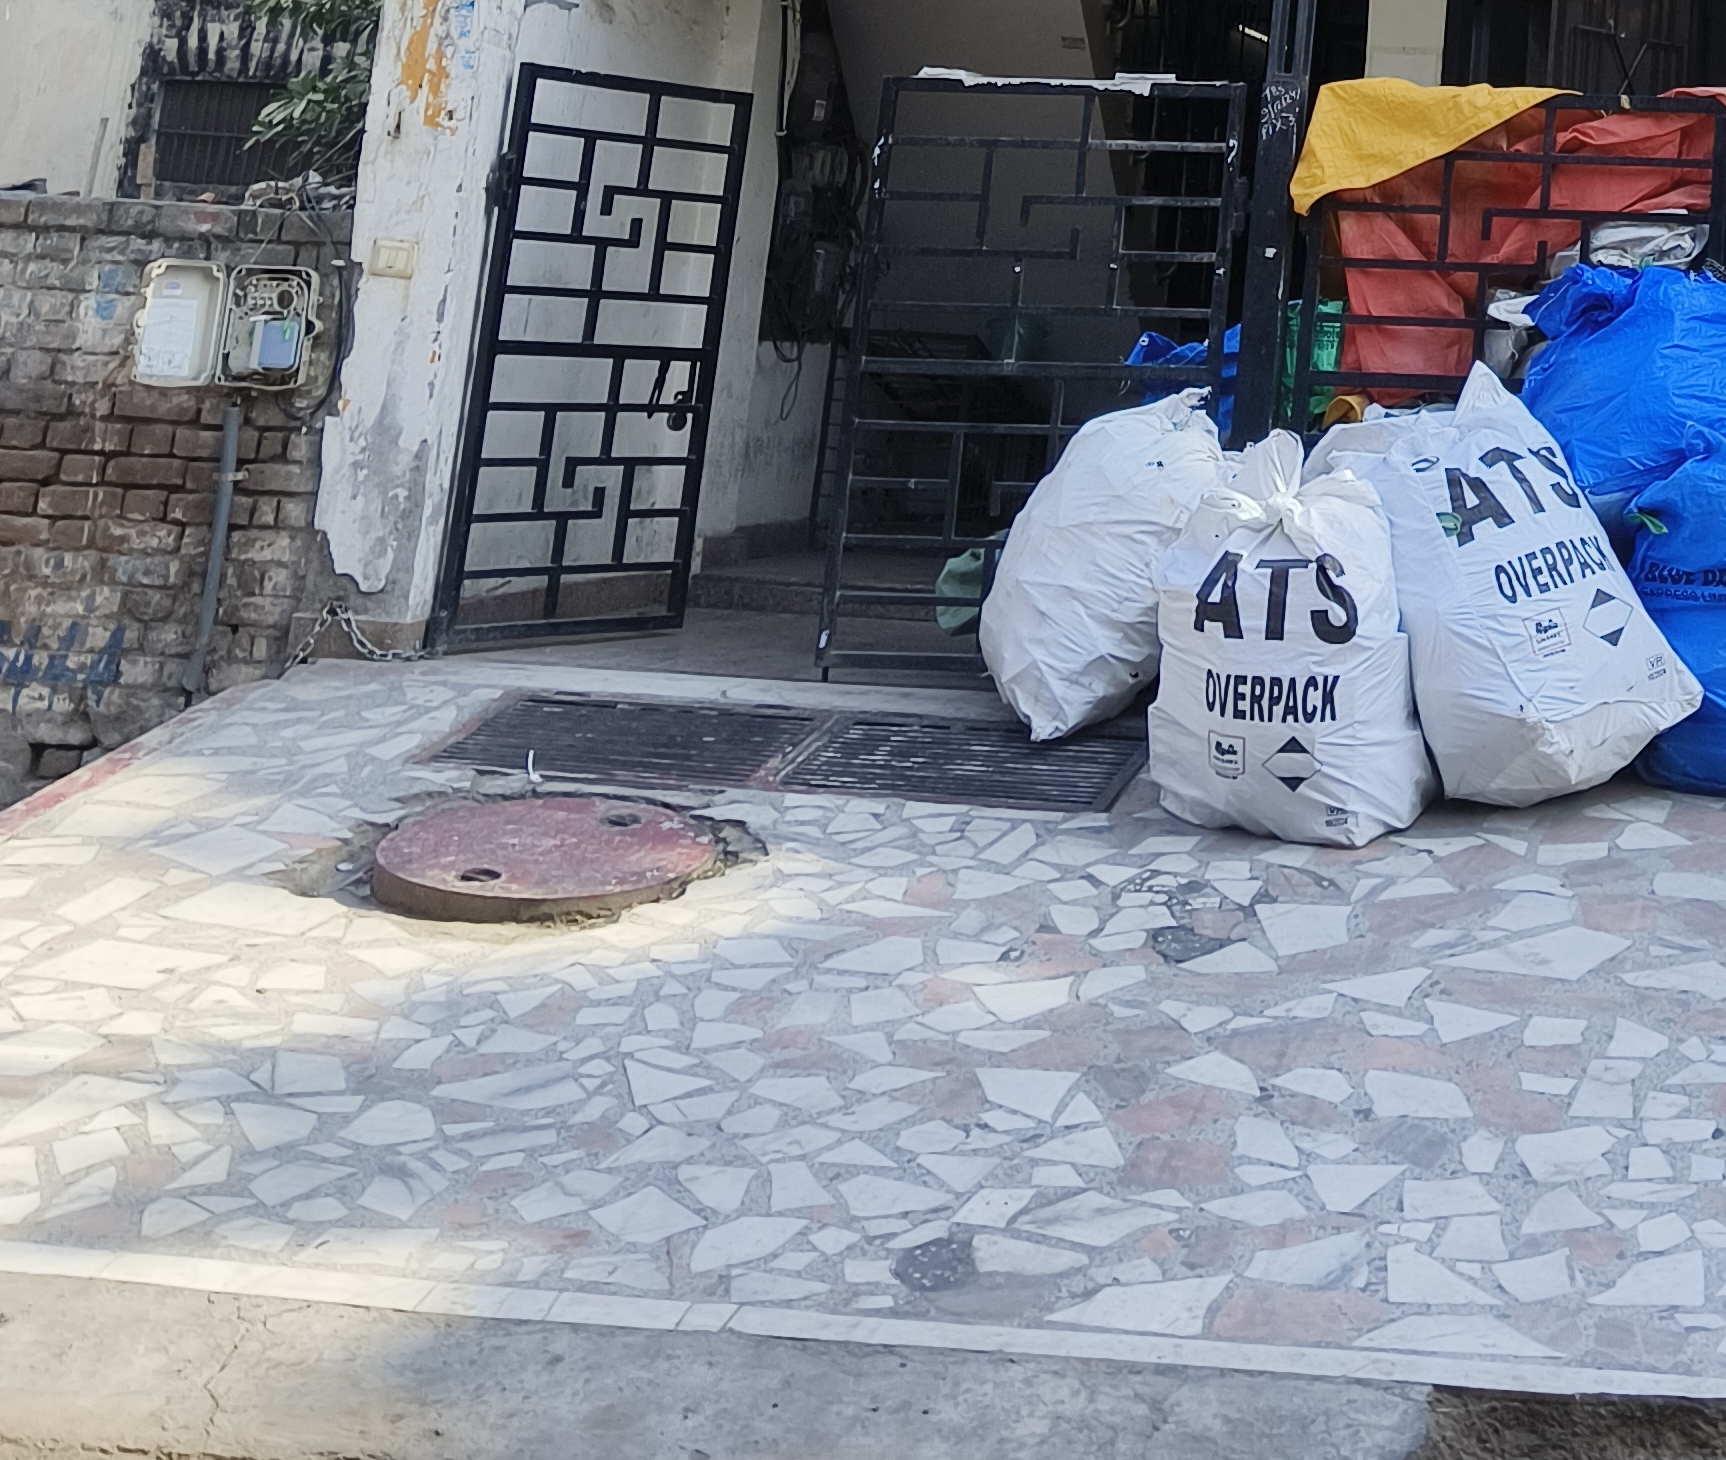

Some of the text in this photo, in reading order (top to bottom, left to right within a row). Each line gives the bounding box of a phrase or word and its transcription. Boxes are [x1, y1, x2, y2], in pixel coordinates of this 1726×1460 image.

[1444, 446, 1582, 548] ATS
[1193, 549, 1359, 645] ATS
[1494, 535, 1616, 605] OVERPACK
[1204, 667, 1341, 724] OVERPACK
